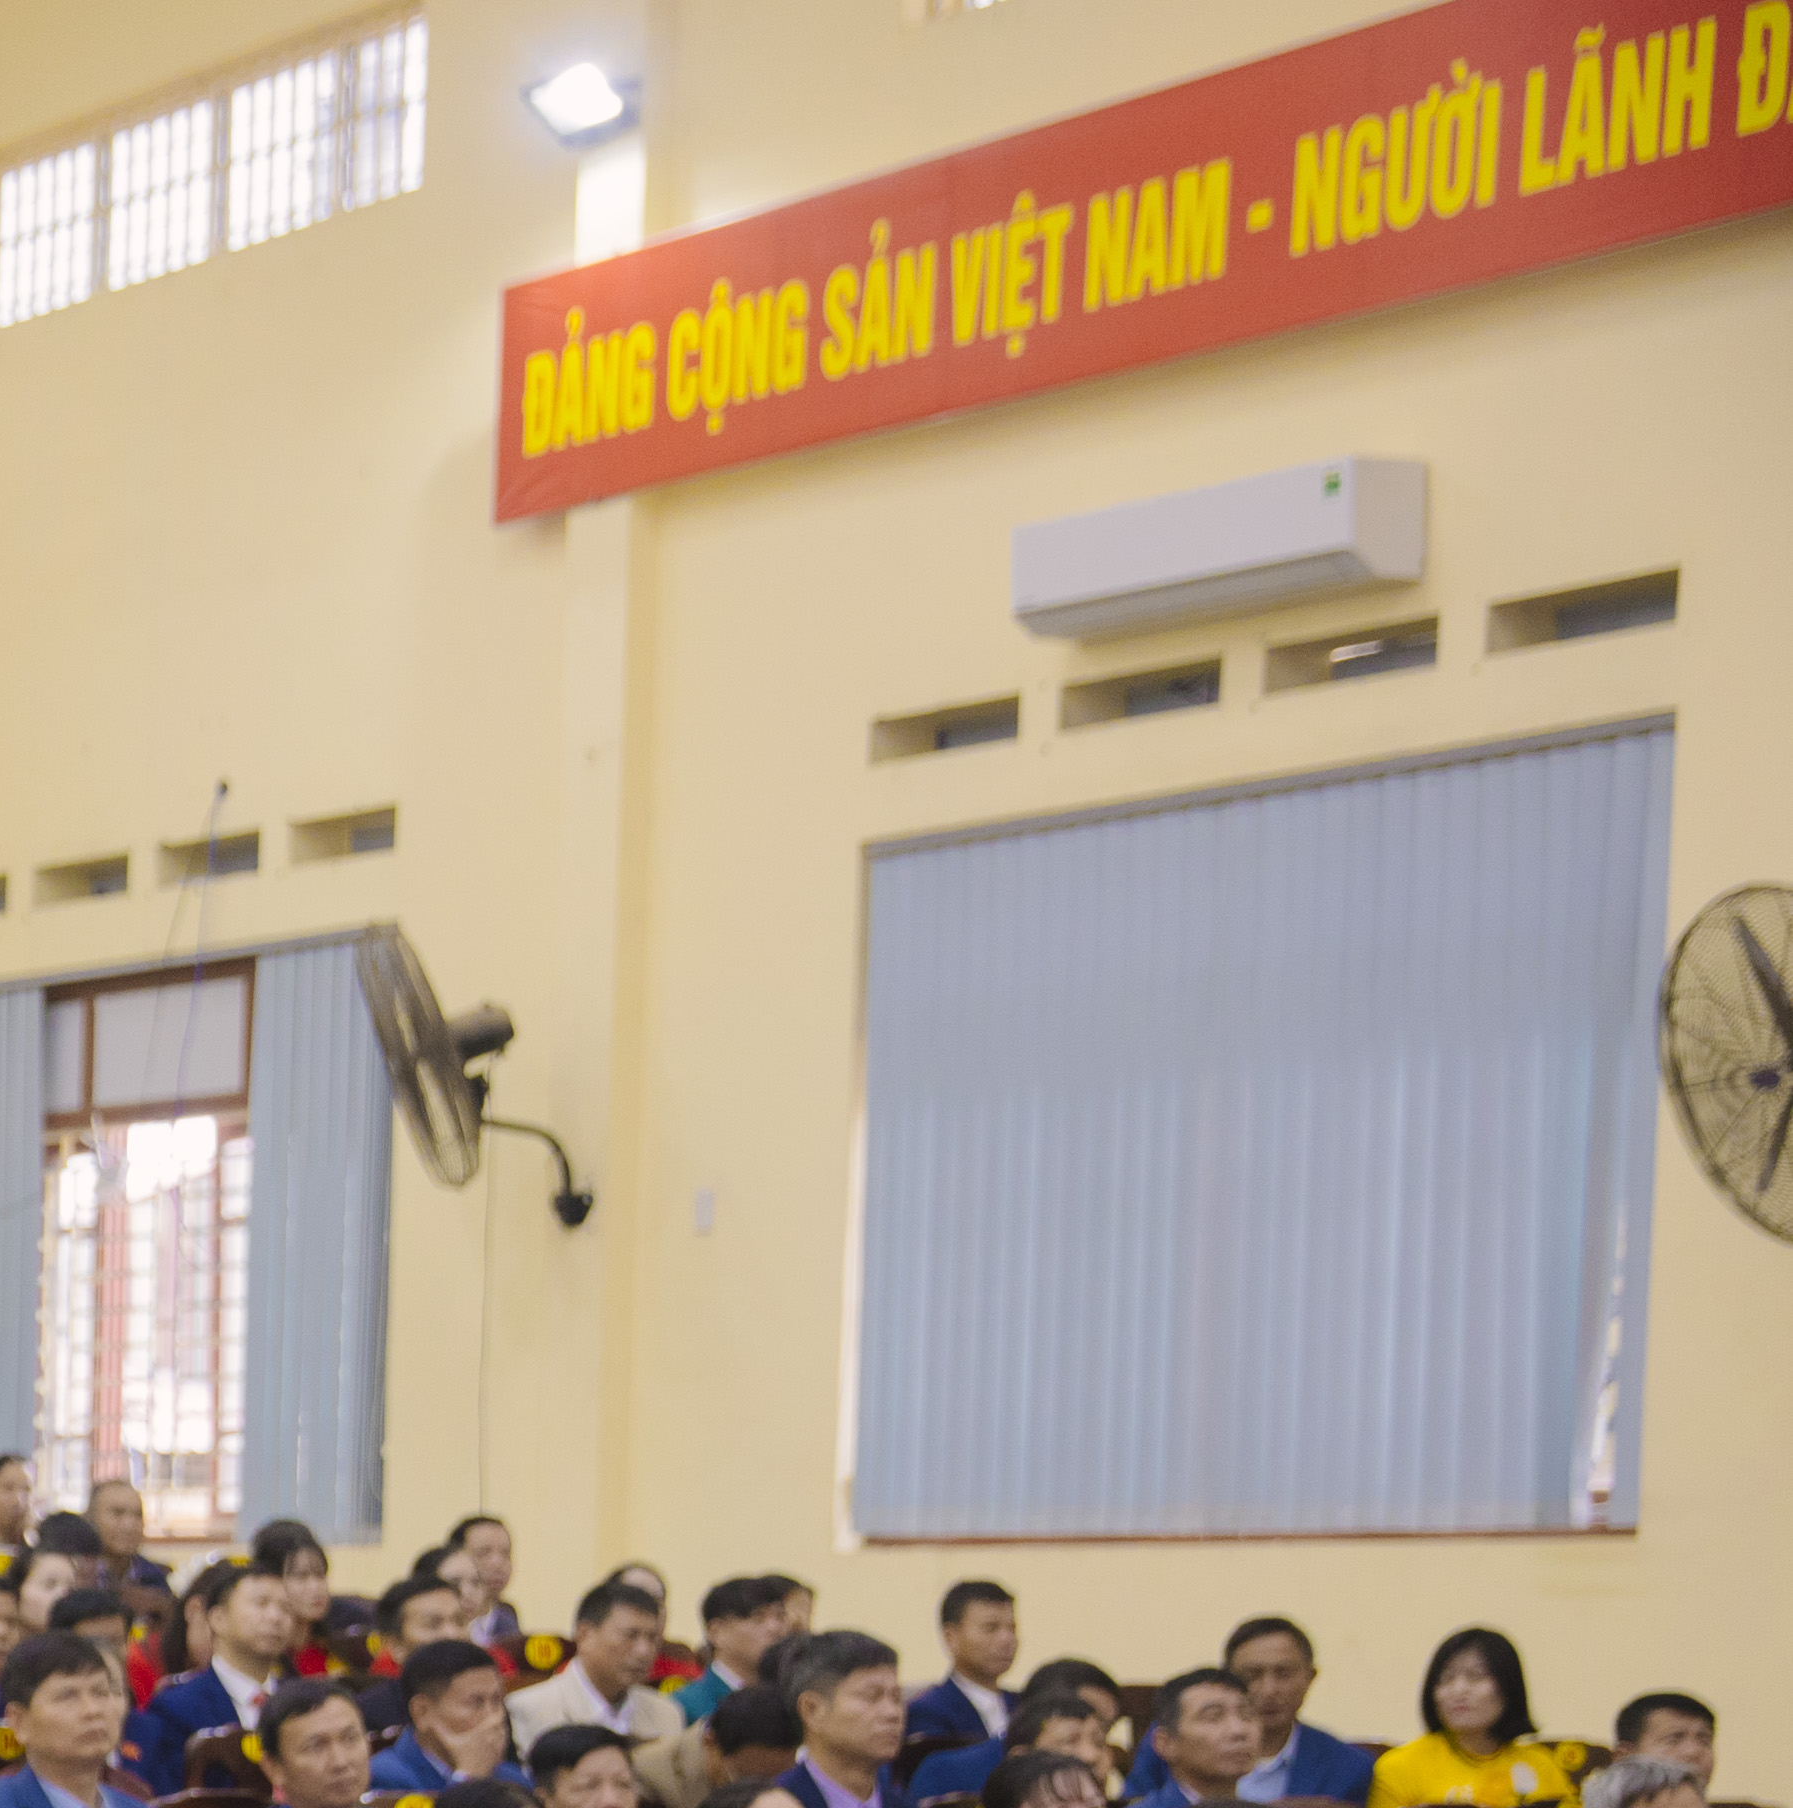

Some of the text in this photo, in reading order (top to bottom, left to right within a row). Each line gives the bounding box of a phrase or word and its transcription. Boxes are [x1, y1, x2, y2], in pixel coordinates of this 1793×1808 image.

[522, 308, 658, 457] ĐẢNG
[665, 280, 808, 434] CỘNG
[820, 222, 936, 380] SẢN
[952, 192, 1073, 355] VIỆT
[1084, 159, 1231, 310] NAM
[1290, 62, 1501, 255] NGƯỜI
[1519, 19, 1716, 194] LÃNH
